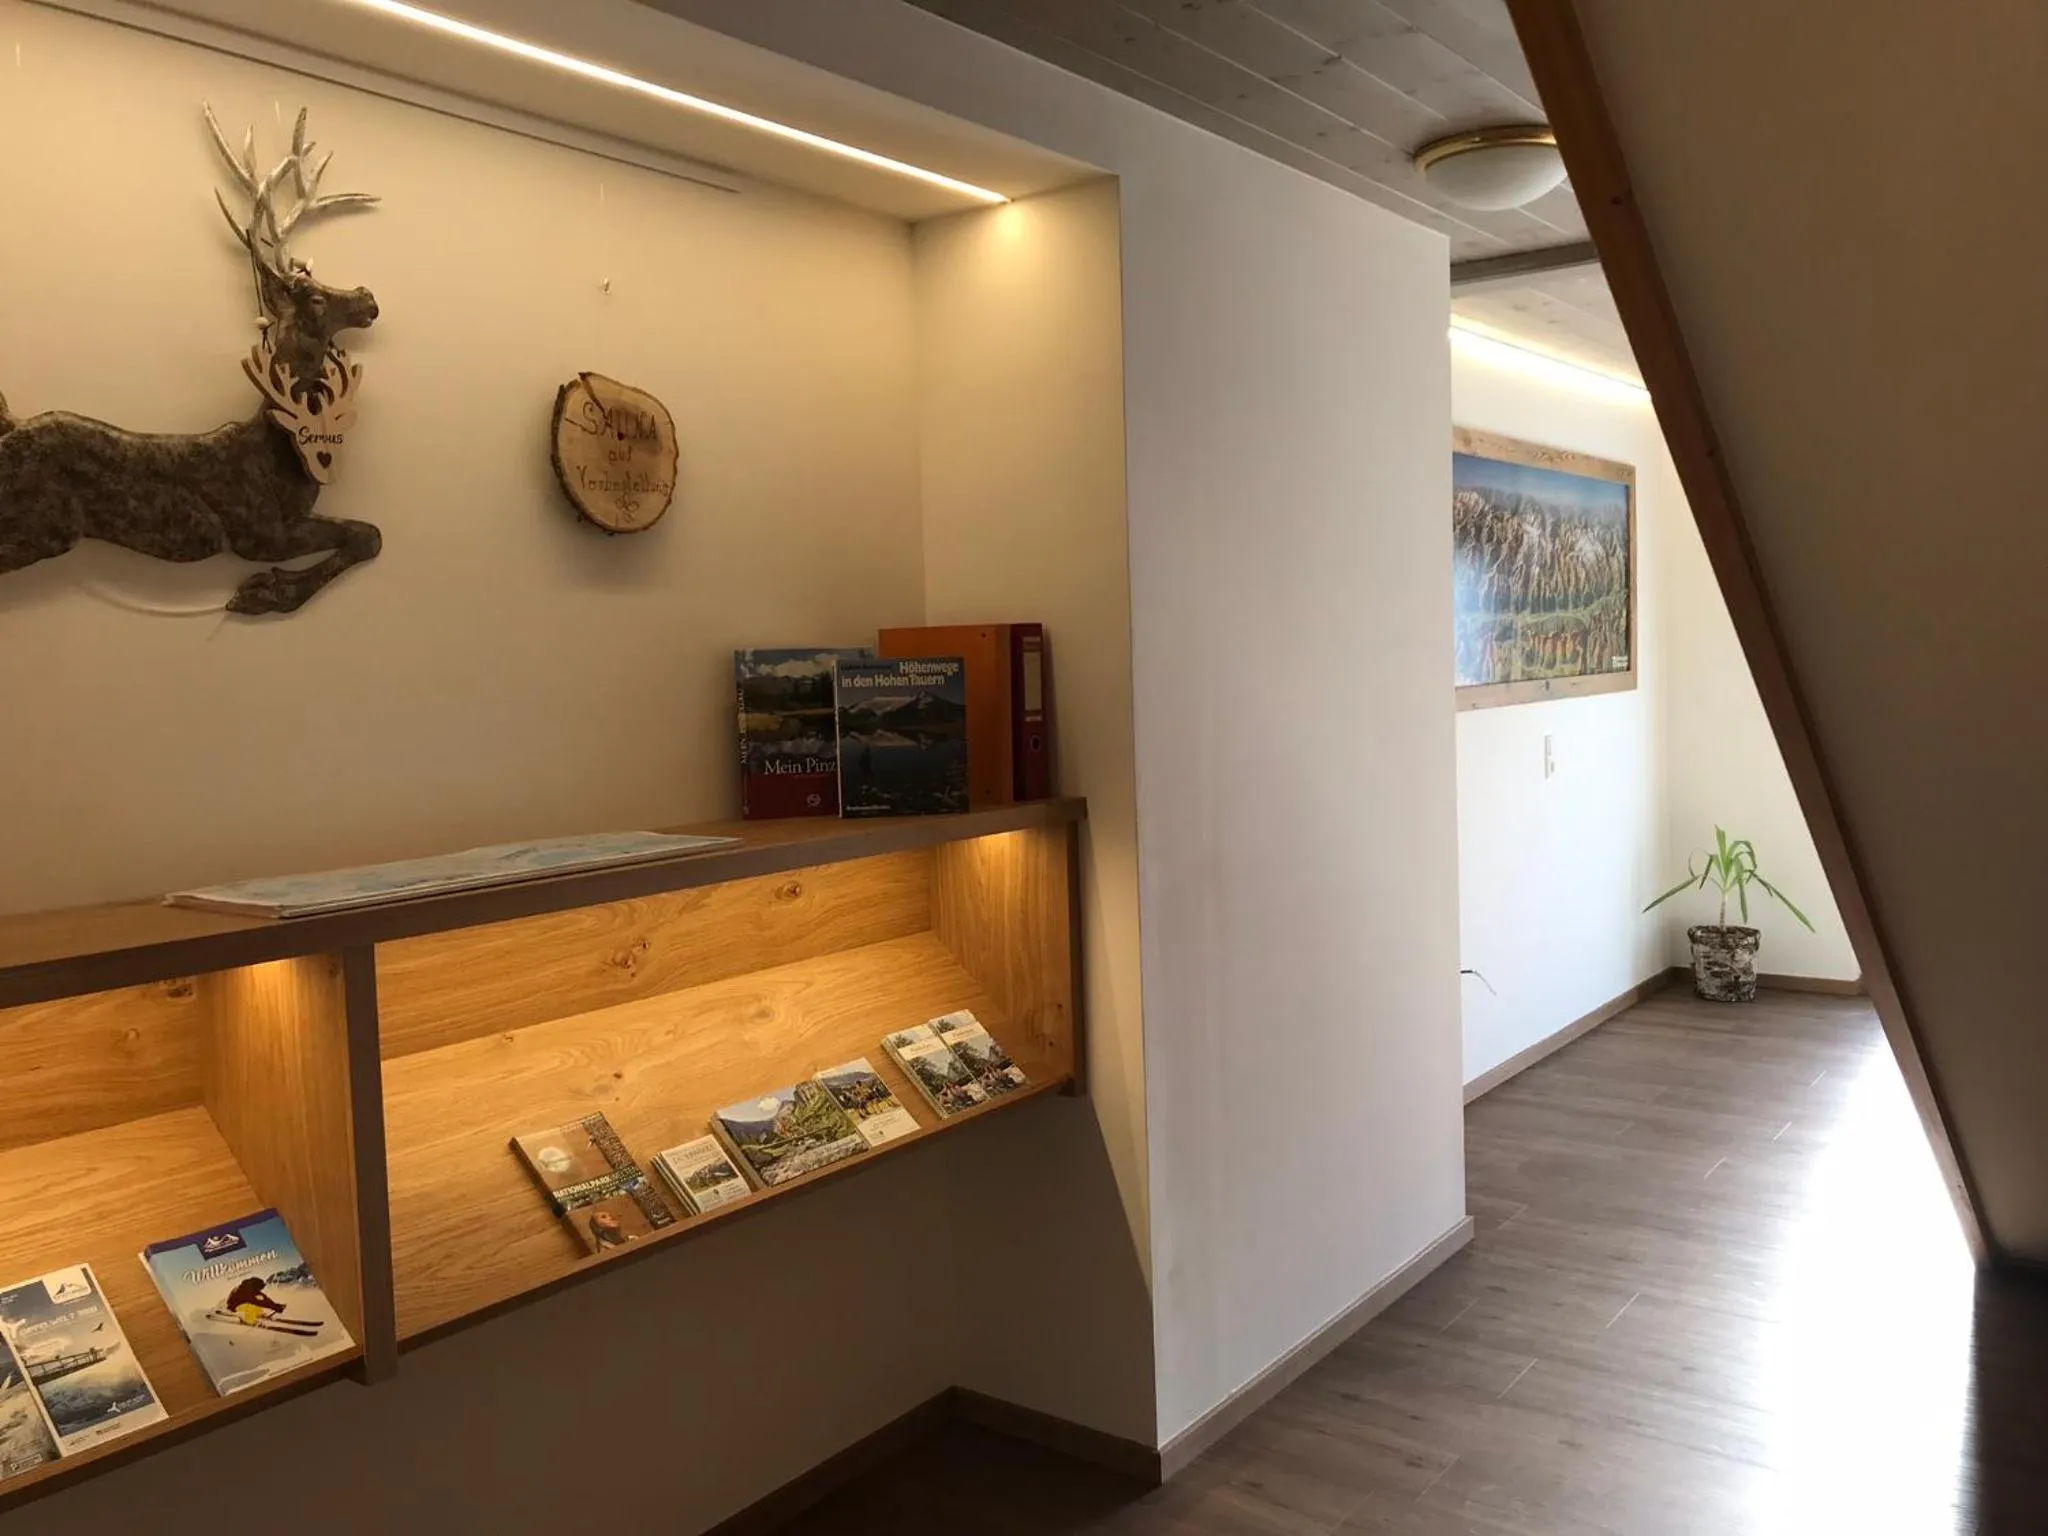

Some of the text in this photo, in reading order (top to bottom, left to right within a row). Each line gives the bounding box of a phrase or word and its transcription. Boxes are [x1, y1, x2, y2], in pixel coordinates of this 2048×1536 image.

[582, 401, 658, 440] SAUNA
[299, 426, 344, 445] Servus
[607, 446, 633, 463] auf
[899, 660, 959, 677] Höhenwege
[841, 671, 945, 688] in den Hohen Tauern
[764, 759, 802, 775] Mein
[553, 1174, 613, 1198] NATIONALPARK
[182, 1248, 278, 1284] Willkommen
